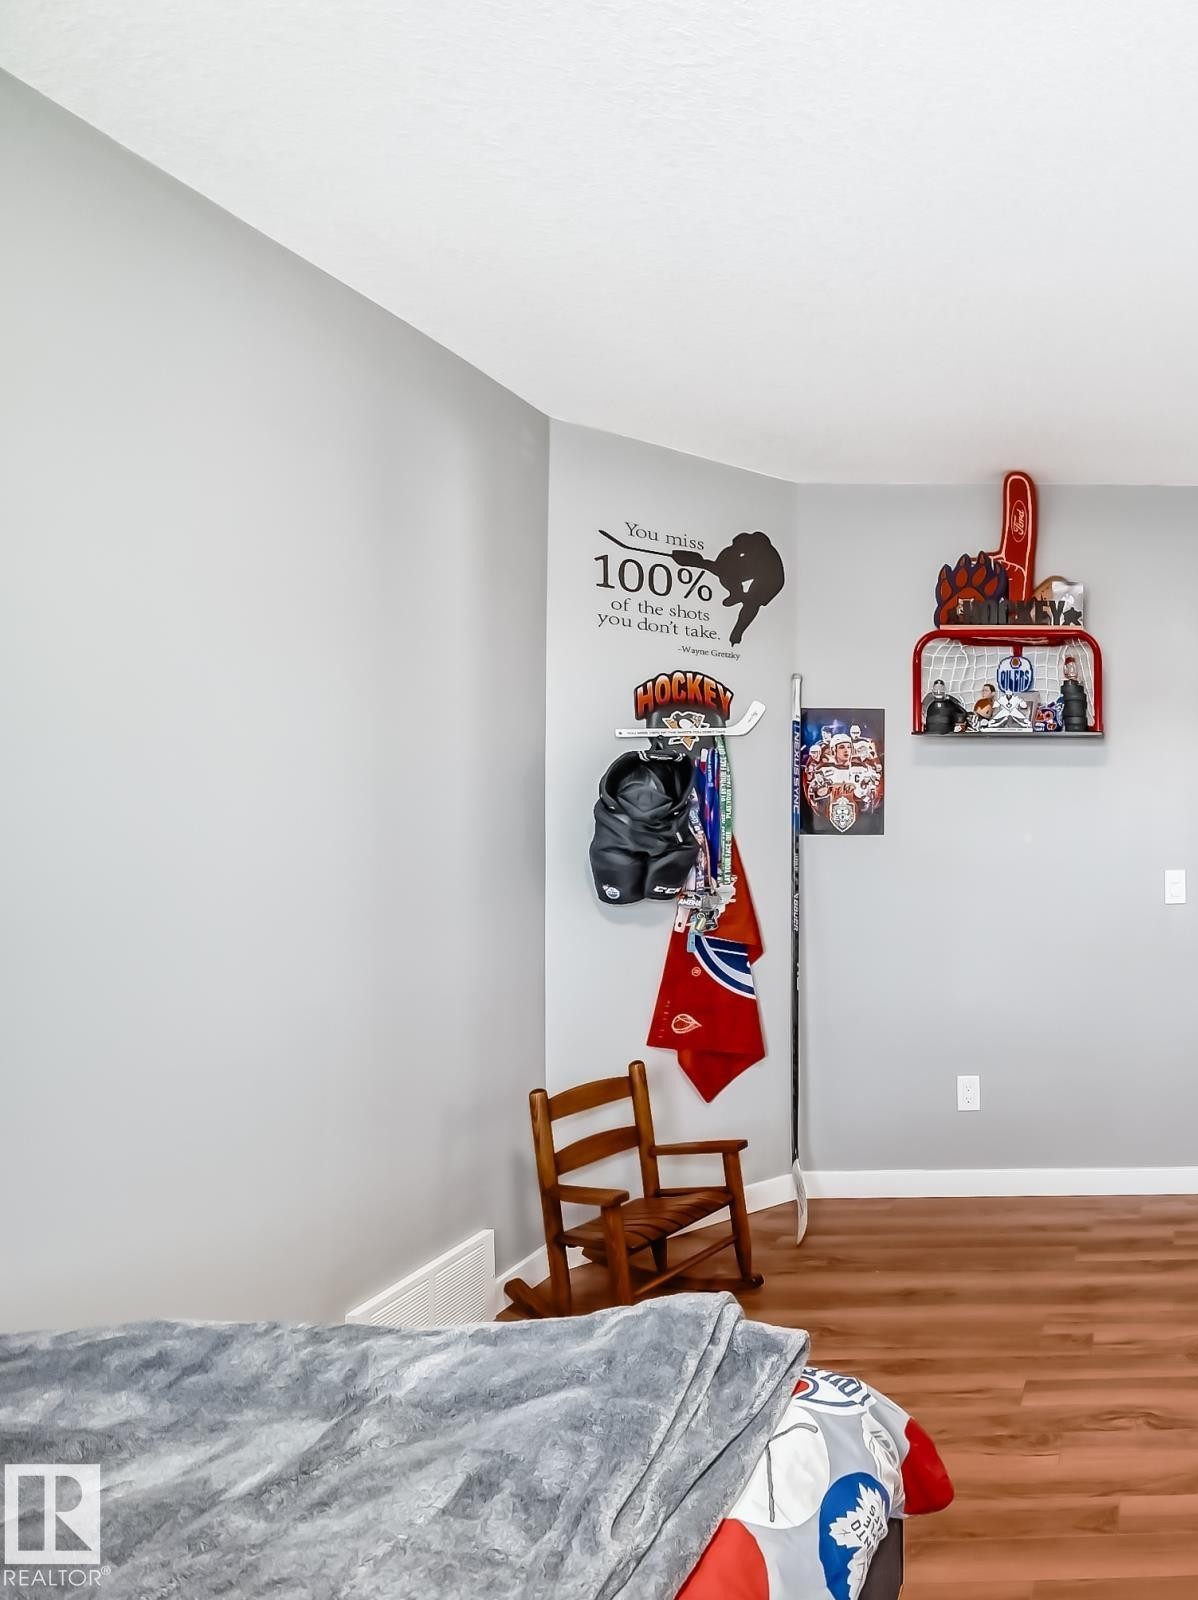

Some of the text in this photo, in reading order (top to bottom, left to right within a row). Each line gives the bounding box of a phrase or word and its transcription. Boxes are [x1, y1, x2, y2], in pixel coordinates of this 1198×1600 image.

[624, 521, 704, 550] You miss
[1013, 509, 1025, 535] Ford
[594, 554, 713, 601] 100%
[611, 598, 710, 621] of the shots
[597, 612, 721, 641] you don't take.
[710, 649, 740, 661] Gretzky
[637, 671, 733, 718] HOCKEY
[1000, 670, 1030, 692] OILERS
